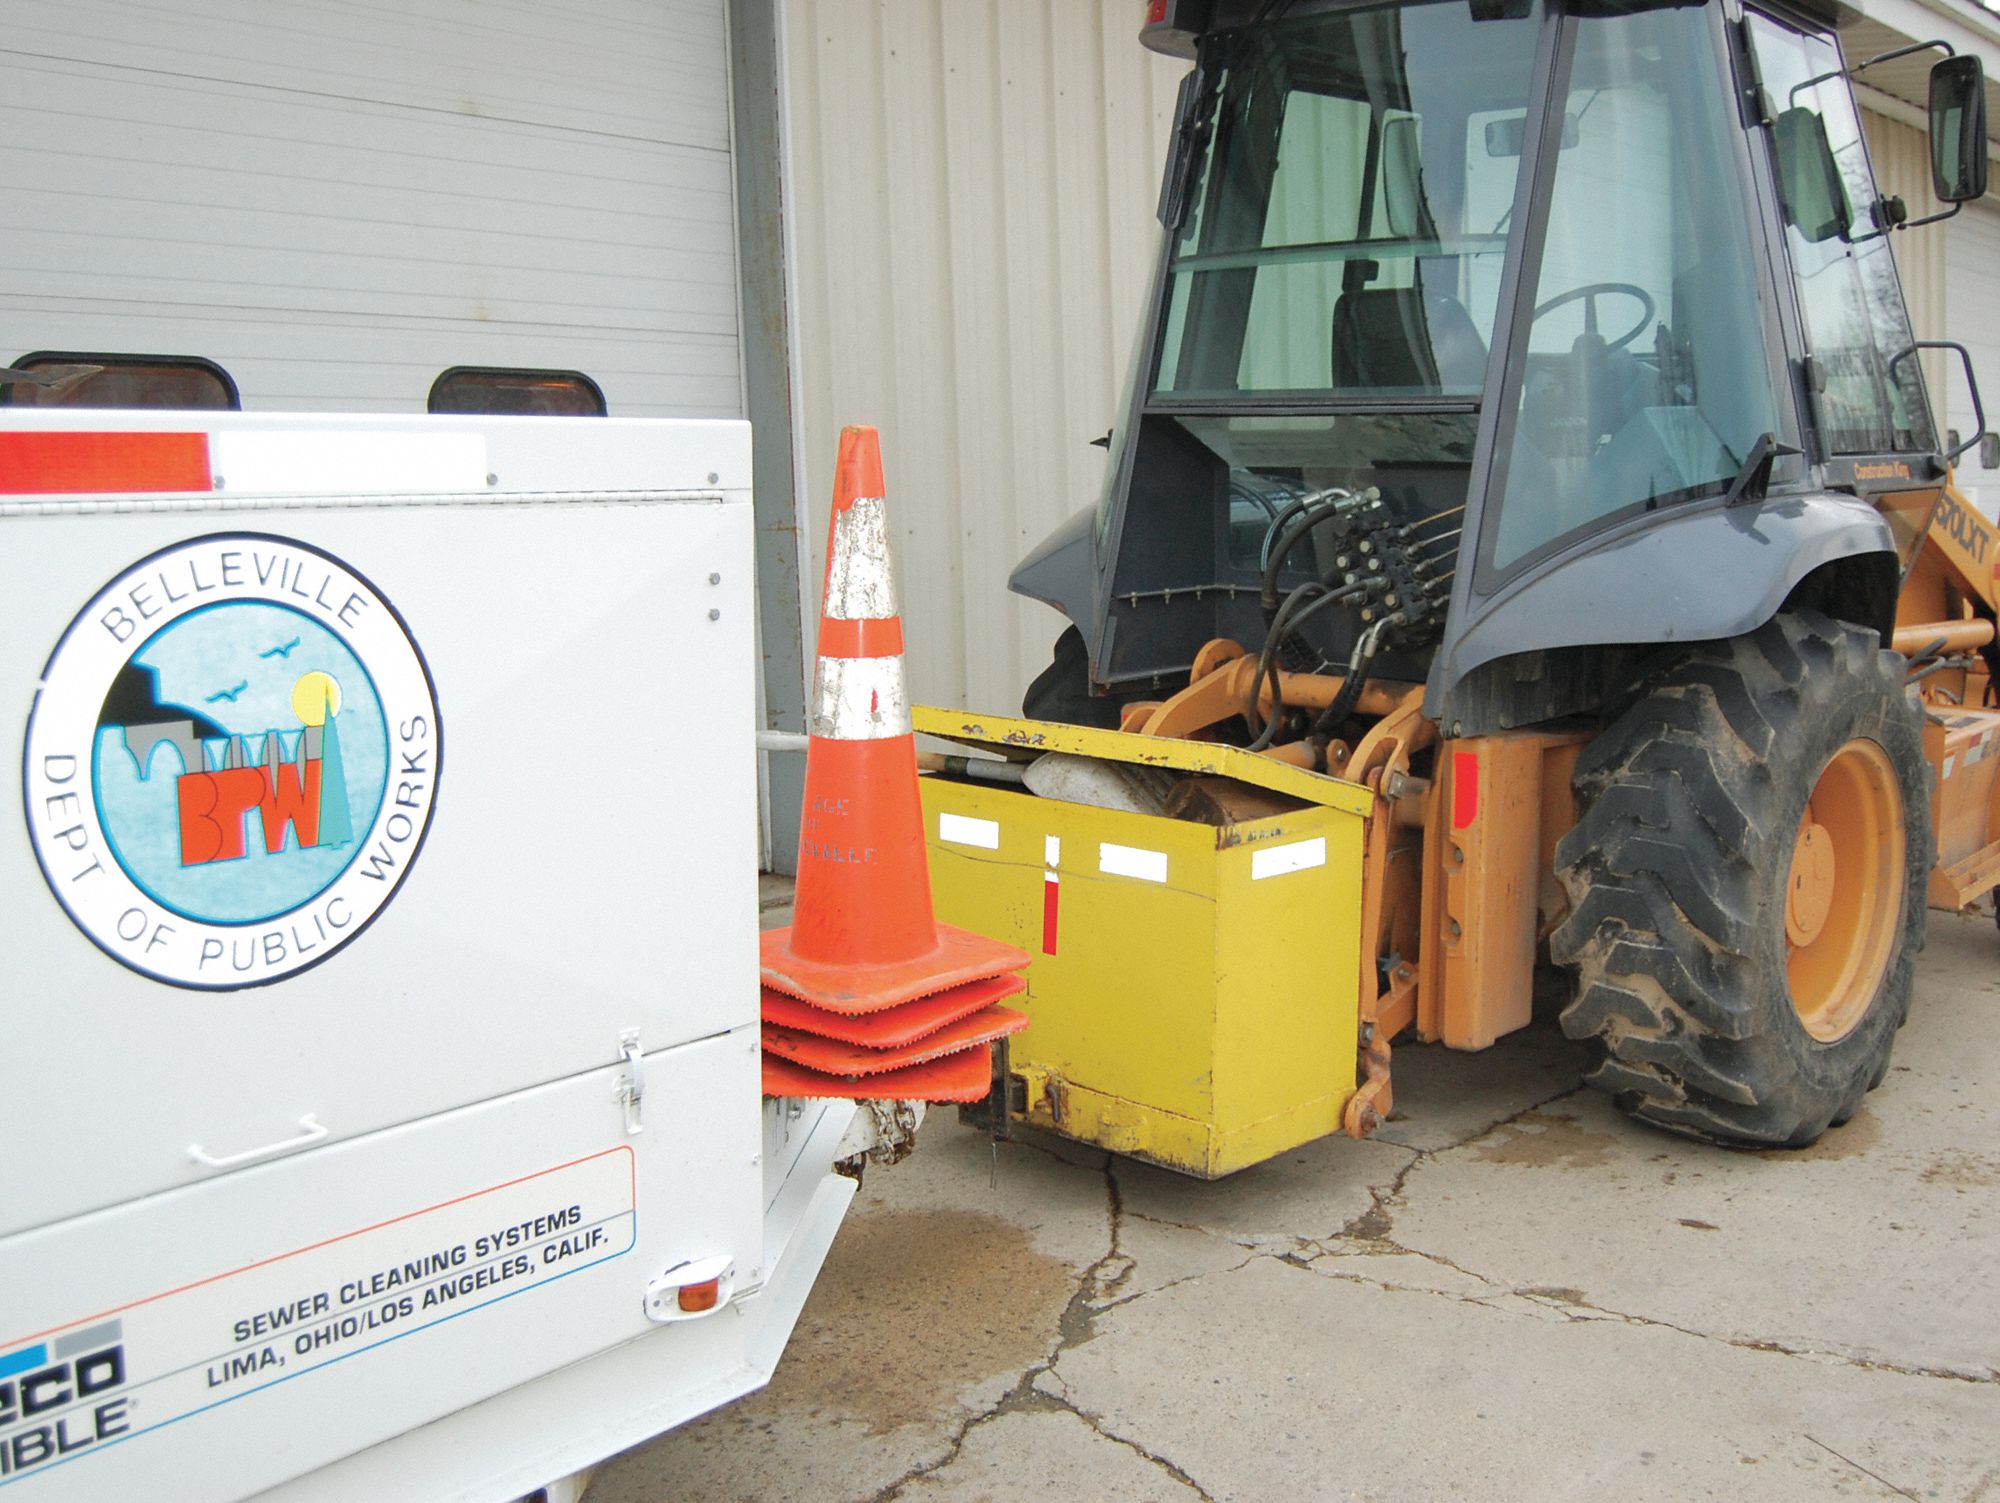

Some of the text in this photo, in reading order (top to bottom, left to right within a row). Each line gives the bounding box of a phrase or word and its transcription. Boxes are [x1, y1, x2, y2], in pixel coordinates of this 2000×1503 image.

[100, 552, 368, 643] BELLEVILLE
[44, 714, 428, 971] DEPT OF PUBLIC WORKS
[177, 758, 323, 868] BPW
[207, 1227, 608, 1388] LIMA, OHIO/LOS ANGELES, CALIF.
[234, 1205, 581, 1342] SEWER CLEANING SYSTEMS
[0, 1397, 130, 1477] IBLE
